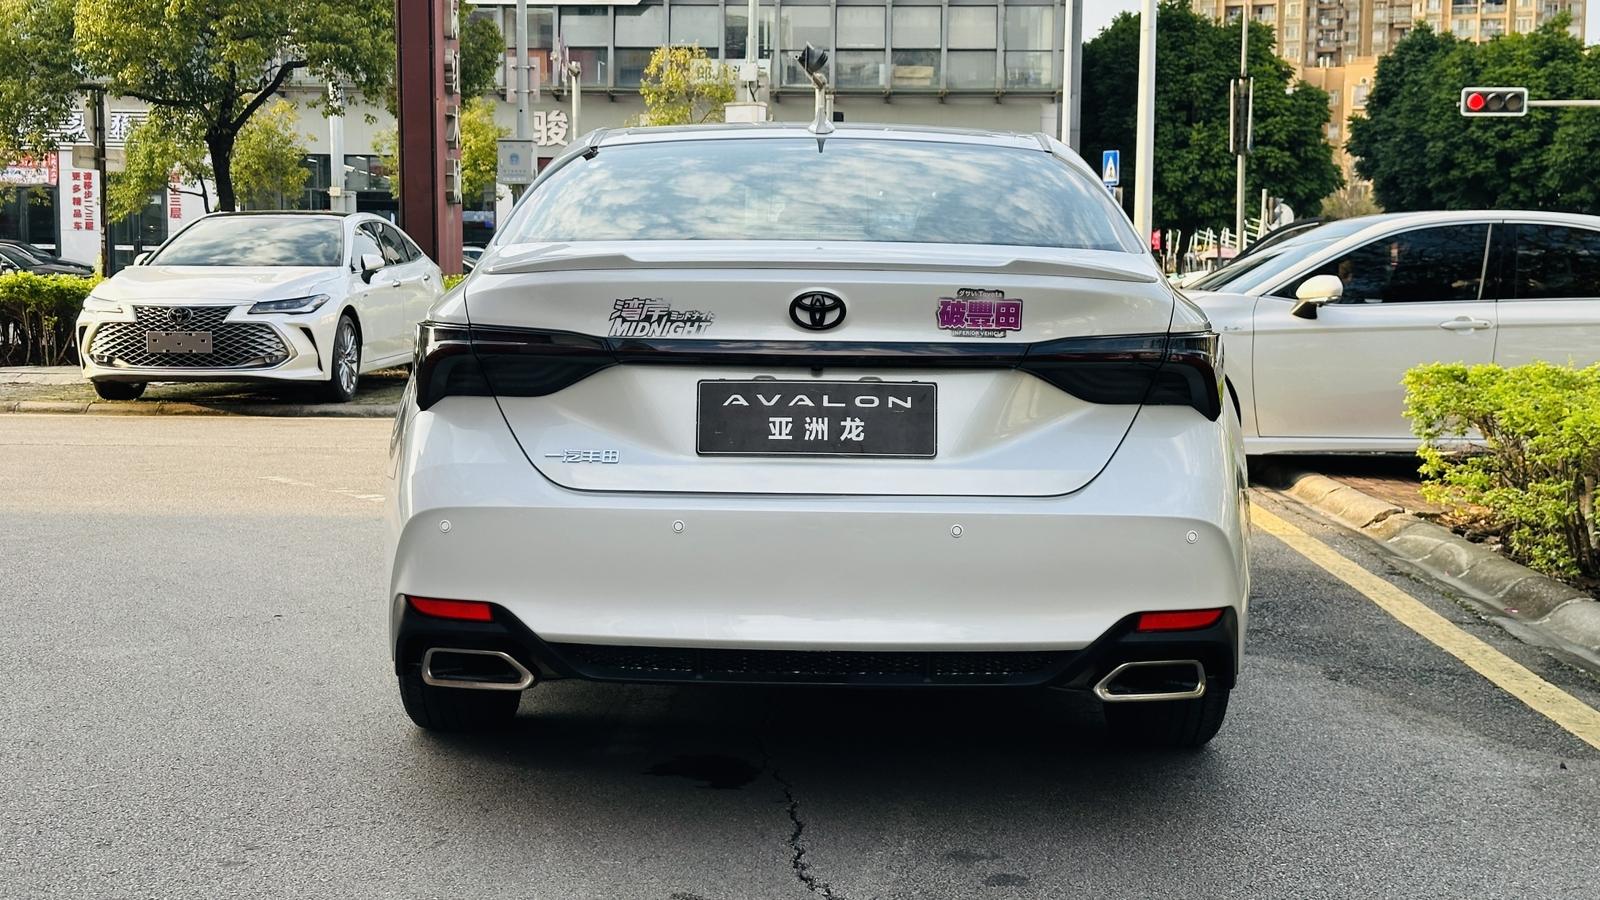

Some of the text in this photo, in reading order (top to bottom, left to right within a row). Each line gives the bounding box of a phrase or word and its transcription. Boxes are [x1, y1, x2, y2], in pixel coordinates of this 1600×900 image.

[533, 110, 570, 147] 骏
[71, 171, 83, 231] 更多精品车
[608, 321, 713, 337] MIDNIGHT
[722, 393, 912, 409] AVALON
[767, 416, 865, 442] 亚洲龙
[544, 448, 620, 464] 一汽丰田
